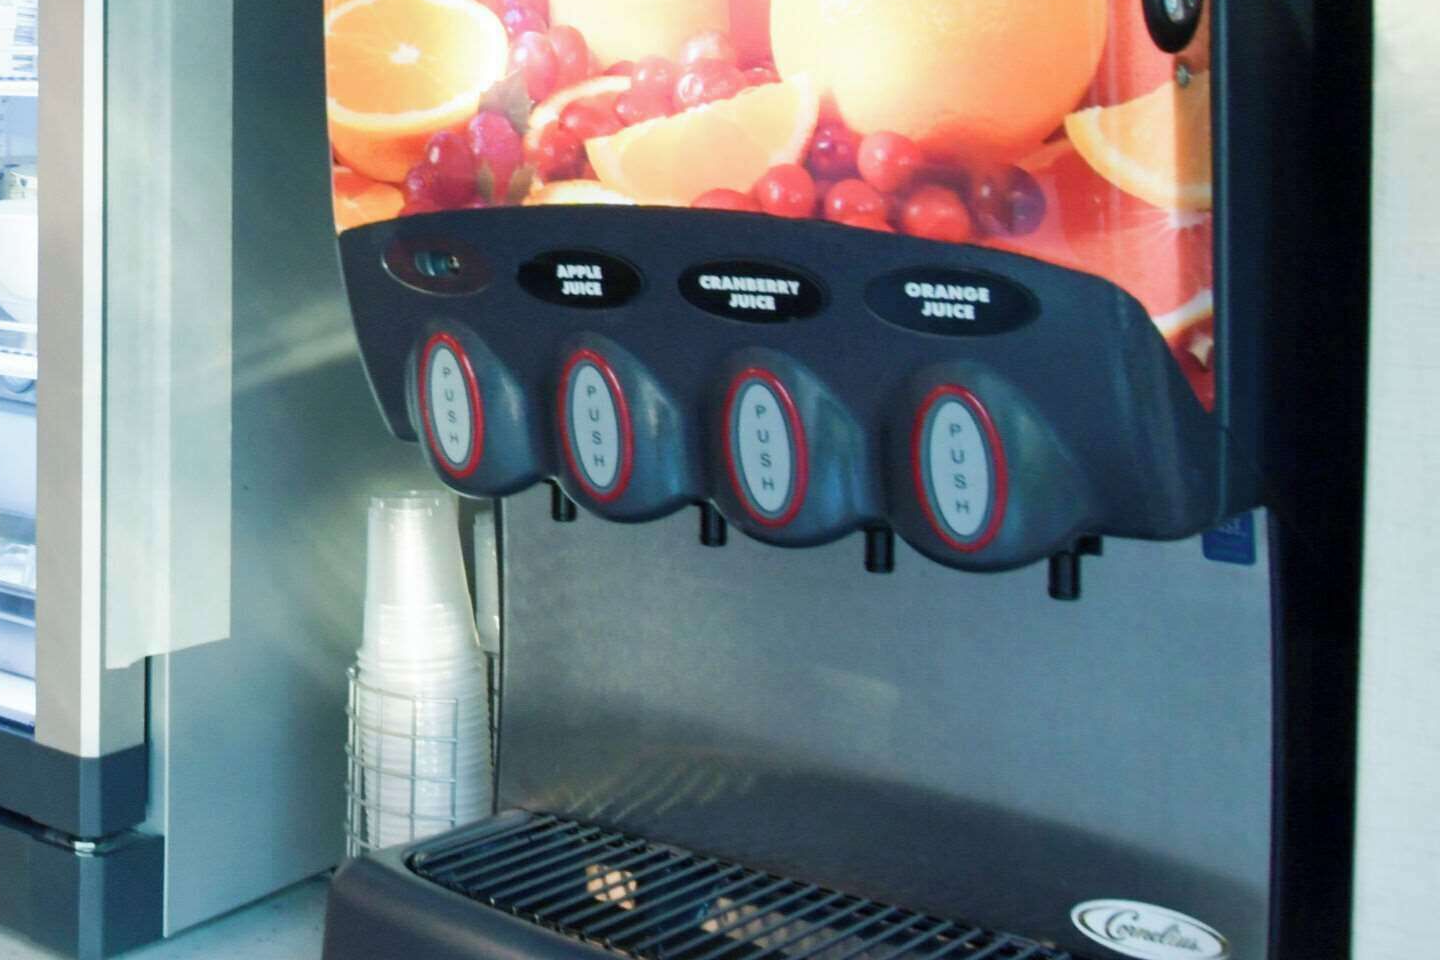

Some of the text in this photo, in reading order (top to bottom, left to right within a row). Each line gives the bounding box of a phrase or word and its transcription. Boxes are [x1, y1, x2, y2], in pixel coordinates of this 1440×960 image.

[556, 264, 603, 279] APPLE
[561, 281, 603, 296] JUICE
[698, 274, 800, 295] CRANBERRY
[904, 282, 990, 303] ORANGE
[728, 292, 776, 311] JUICE
[921, 301, 975, 320] JUICE
[441, 367, 459, 444] PUSH
[587, 384, 605, 467] PUSH
[755, 404, 775, 491] PUSH
[949, 423, 970, 515] PUSH
